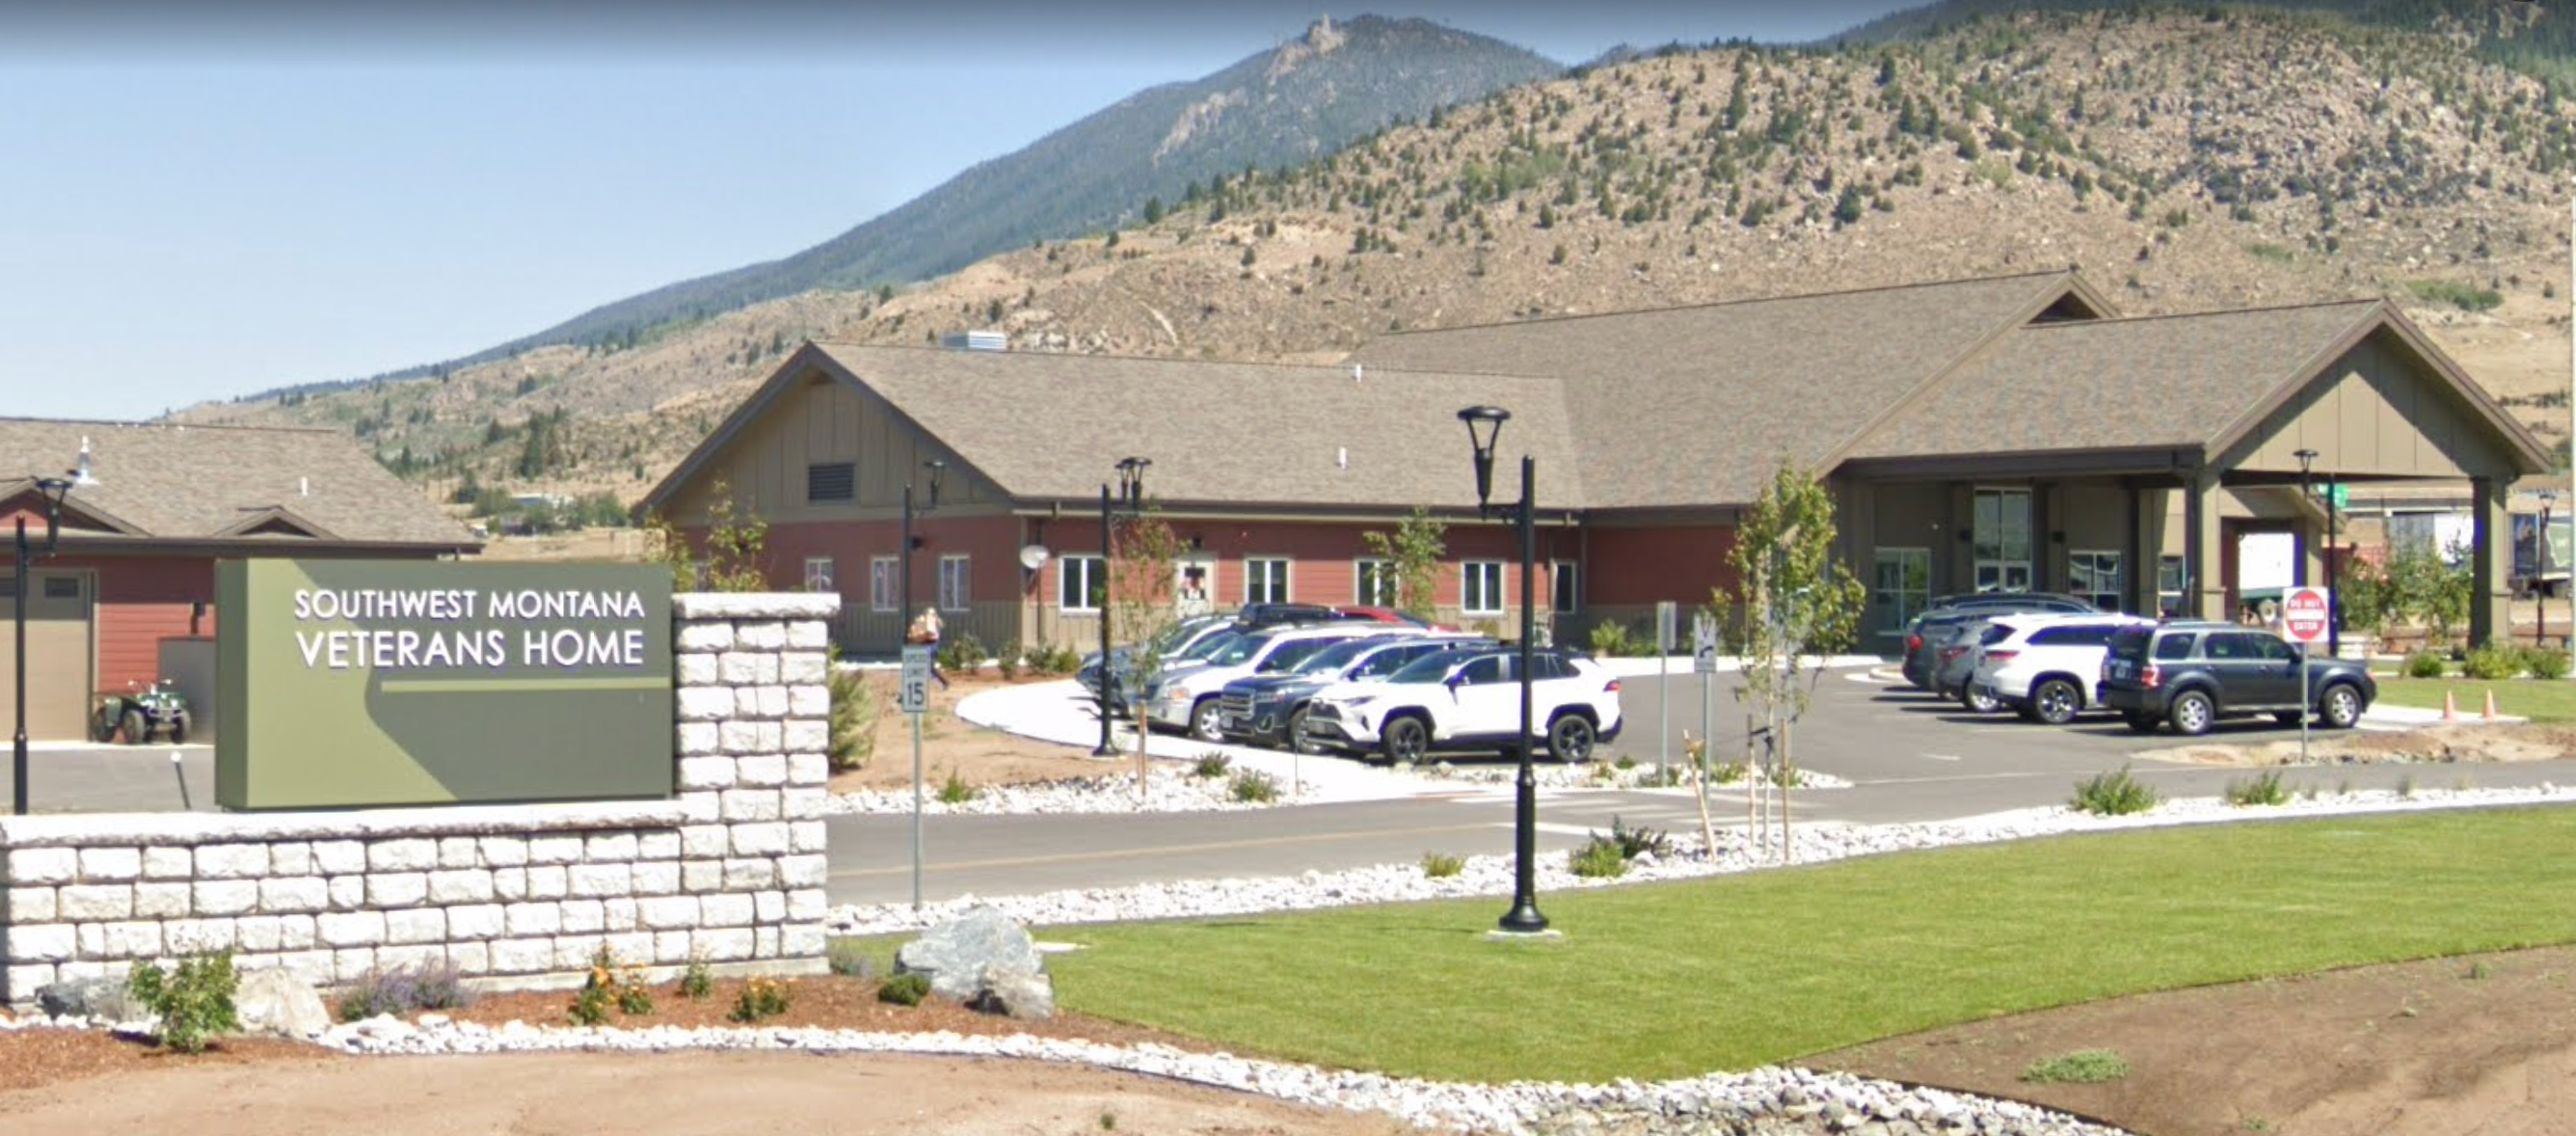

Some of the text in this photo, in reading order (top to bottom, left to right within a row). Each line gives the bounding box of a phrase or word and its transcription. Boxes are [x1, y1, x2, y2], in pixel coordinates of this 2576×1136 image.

[293, 589, 646, 619] SOUTHWEST MONTANA
[2304, 598, 2321, 609] NOT
[2294, 621, 2319, 632] ENTER
[295, 629, 644, 667] VETERANS HOME
[907, 681, 926, 707] 15
